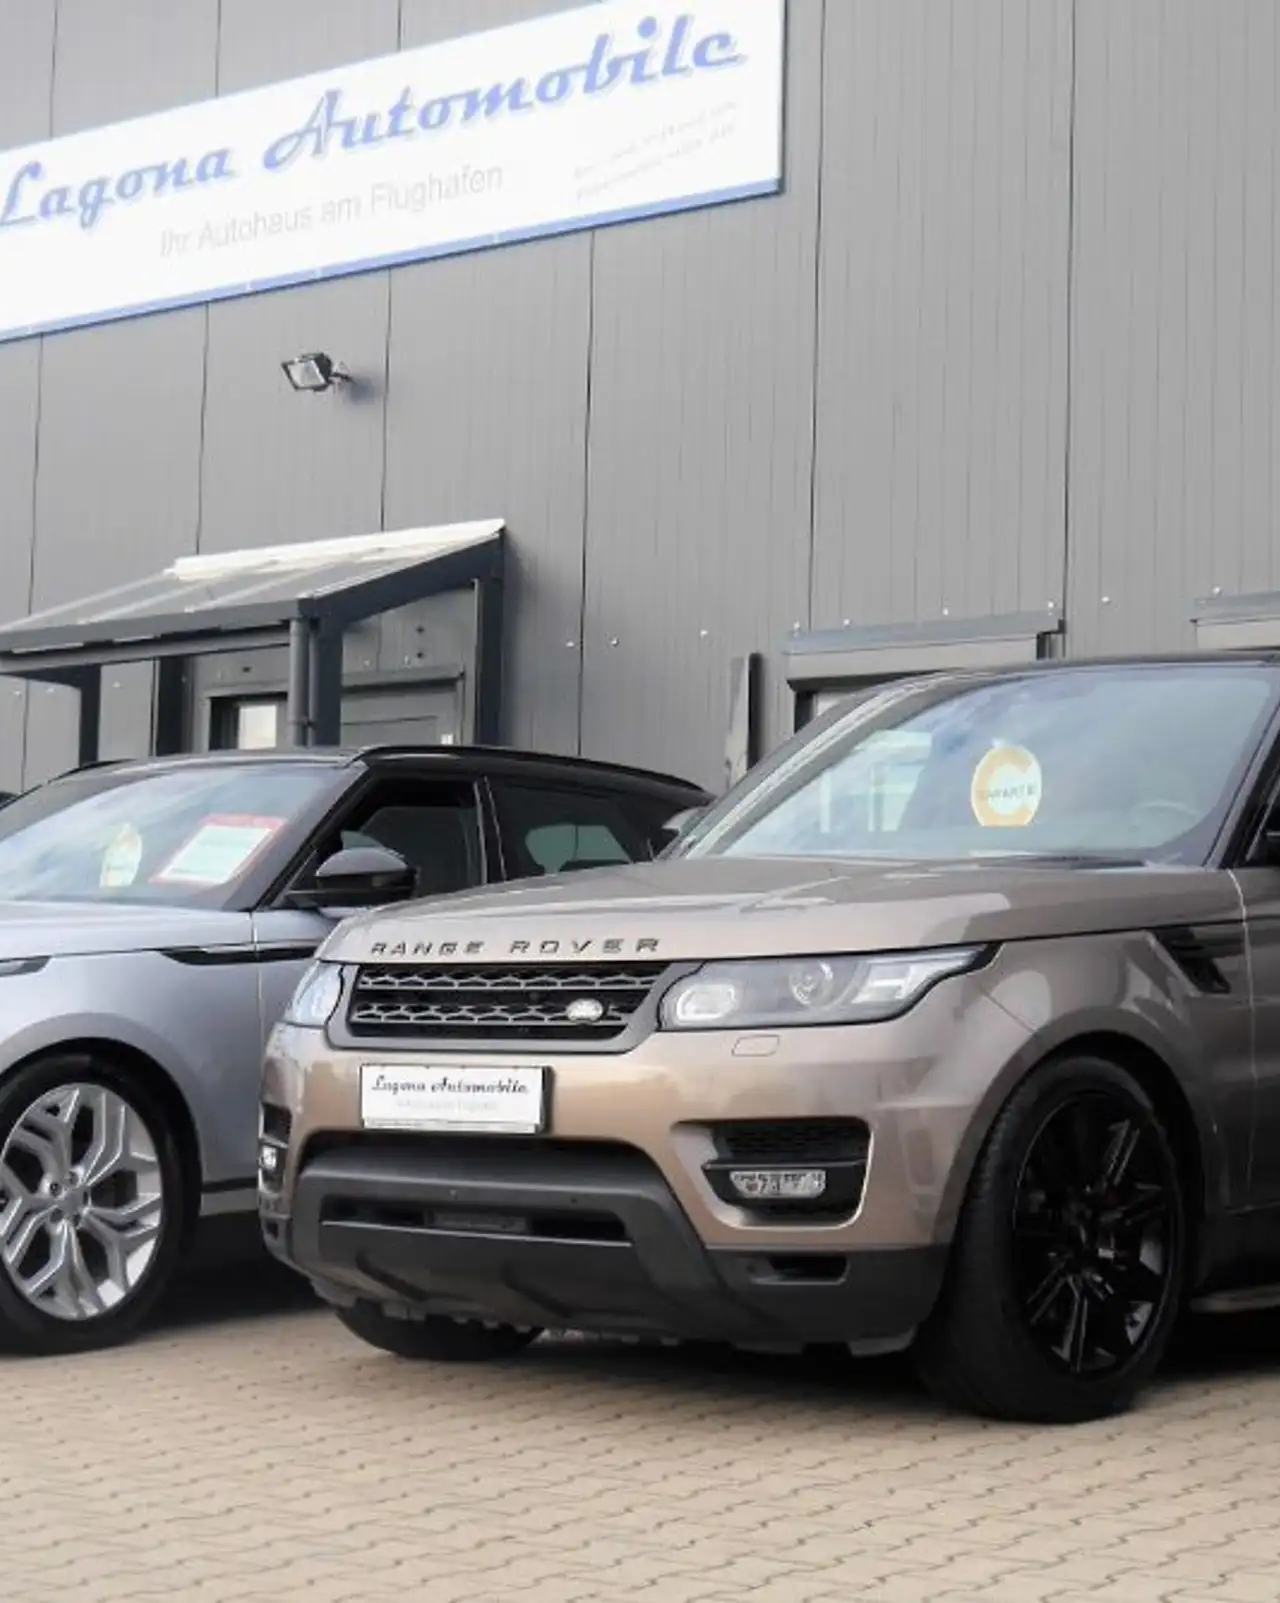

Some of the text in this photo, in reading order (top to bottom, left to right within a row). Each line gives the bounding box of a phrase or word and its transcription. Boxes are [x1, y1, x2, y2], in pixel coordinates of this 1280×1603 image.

[262, 14, 746, 172] Automobile
[160, 162, 504, 258] Ihr Autohaus am Flughafen
[371, 938, 661, 956] RANGE ROVER
